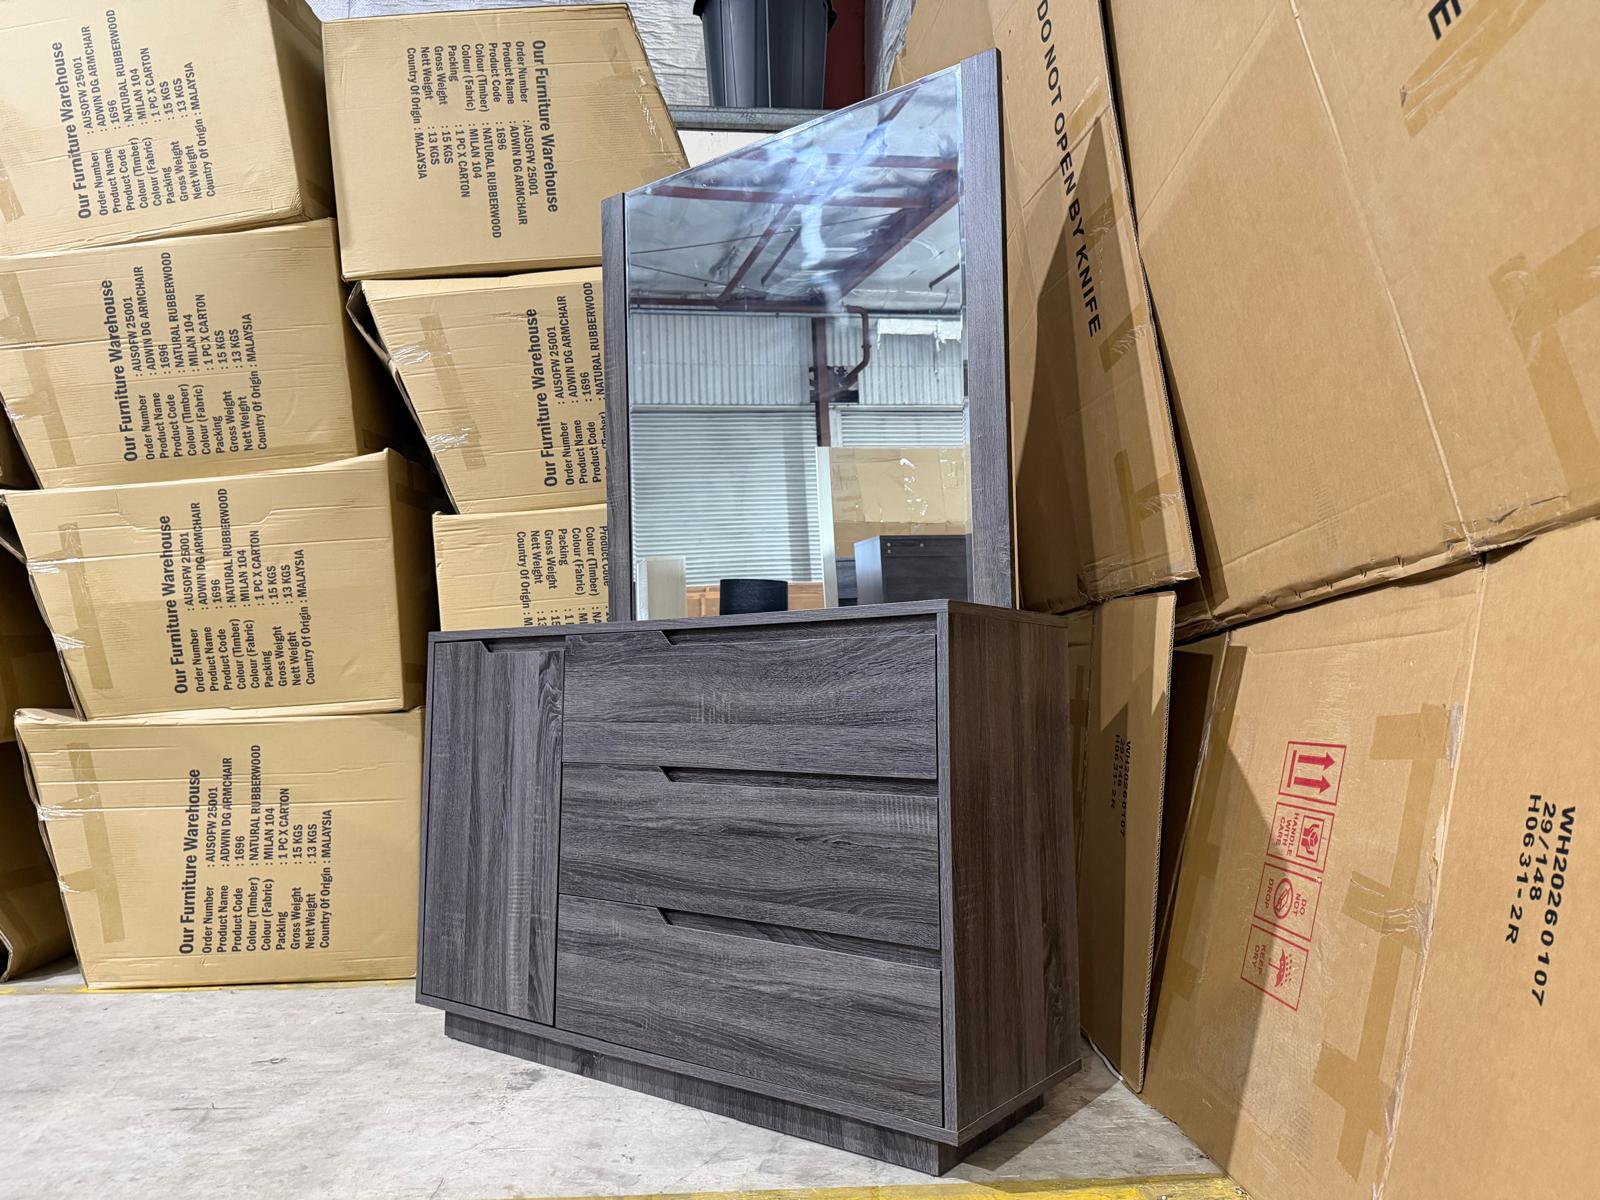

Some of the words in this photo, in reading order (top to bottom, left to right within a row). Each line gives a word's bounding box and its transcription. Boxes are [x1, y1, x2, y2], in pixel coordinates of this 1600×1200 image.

[1037, 0, 1052, 42] DO
[407, 48, 417, 82] Country
[421, 47, 431, 66] Nett
[434, 46, 443, 71] Gross
[448, 45, 459, 81] Packing
[461, 44, 471, 73] Colour
[475, 44, 485, 72] Colour
[488, 43, 500, 77] Product
[502, 42, 513, 76] Product
[515, 41, 525, 65] Order
[532, 40, 545, 64] Our
[52, 42, 74, 122] Warehouse
[72, 56, 86, 87] 25001
[422, 68, 433, 99] Weight
[518, 68, 529, 103] Number
[1044, 45, 1062, 107] NOT
[410, 85, 420, 95] Of
[436, 73, 448, 105] Weight
[462, 75, 476, 111] (Fabric)
[476, 75, 490, 112] (Timber)
[492, 79, 502, 102] Code
[505, 78, 515, 104] Name
[535, 68, 551, 131] Furniture
[78, 90, 93, 128] AUSOFW
[410, 97, 422, 123] Origin
[428, 132, 438, 143] 13
[442, 131, 451, 142] 15
[456, 138, 466, 150] PC
[469, 129, 480, 158] MILAN
[483, 128, 495, 169] NATURAL
[496, 128, 507, 150] 1696
[510, 126, 521, 156] ADWIN
[523, 125, 535, 163] AUSOFW
[66, 125, 87, 190] Furniture
[414, 133, 426, 179] MALAYSIA
[429, 146, 439, 164] KGS
[443, 145, 453, 163] KGS
[513, 159, 523, 172] DG
[1055, 112, 1077, 196] OPEN
[91, 152, 103, 188] Number
[458, 160, 470, 197] CARTON
[472, 161, 482, 179] 104
[527, 166, 538, 196] 25001
[541, 134, 558, 211] Warehouse
[78, 194, 92, 218] Our
[97, 190, 108, 215] Order
[486, 172, 501, 238] RUBBERWOOD
[514, 174, 527, 224] ARMCHAIR
[1068, 198, 1084, 237] BY
[1076, 245, 1101, 337] KNIFE
[101, 280, 122, 362] Warehouse
[123, 297, 136, 328] 25001
[557, 296, 572, 347] ARMCHAIR
[583, 282, 600, 350] RUBBERWOOD
[127, 331, 142, 371] AUSOFW
[526, 309, 545, 390] Warehouse
[546, 326, 559, 356] 25001
[563, 350, 573, 364] DG
[550, 359, 564, 398] AUSOFW
[565, 366, 577, 397] ADWIN
[580, 372, 591, 395] 1696
[591, 352, 606, 395] NATURAL
[113, 366, 133, 432] Furniture
[138, 395, 150, 432] Number
[536, 393, 554, 458] Furniture
[560, 421, 571, 457] Number
[574, 420, 583, 446] Name
[586, 421, 597, 445] Code
[123, 436, 137, 461] Our
[143, 434, 155, 459] Order
[544, 461, 558, 486] Our
[564, 459, 575, 484] Order
[575, 448, 588, 483] Product
[589, 446, 602, 482] Product
[179, 532, 191, 563] 25001
[517, 531, 527, 567] Country
[530, 530, 541, 550] Nett
[544, 529, 554, 555] Gross
[558, 528, 569, 565] Packing
[572, 527, 582, 557] Colour
[586, 526, 595, 556] Colour
[159, 516, 176, 596] Warehouse
[531, 552, 543, 584] Weight
[182, 566, 195, 605] AUSOFW
[520, 569, 529, 579] Of
[546, 557, 557, 589] Weight
[572, 559, 585, 595] (Fabric)
[586, 558, 599, 596] (Timber)
[520, 582, 531, 608] Origin
[167, 600, 184, 665] Furniture
[190, 629, 201, 665] Number
[173, 669, 187, 693] Our
[194, 667, 204, 692] Order
[222, 758, 233, 810] ARMCHAIR
[251, 745, 262, 814] RUBBERWOOD
[183, 769, 200, 851] Warehouse
[207, 787, 217, 818] 25001
[265, 807, 274, 826] 104
[279, 788, 289, 827] CARTON
[221, 812, 231, 826] DG
[293, 824, 303, 844] KGS
[307, 824, 317, 843] KGS
[321, 810, 332, 858] MALAYSIA
[1275, 816, 1286, 847] CARE
[1281, 819, 1292, 847] WITH
[1286, 812, 1299, 856] HANDLE
[205, 821, 216, 862] AUSOFW
[220, 829, 230, 861] ADWIN
[234, 836, 244, 860] 1696
[249, 816, 260, 860] NATURAL
[263, 829, 274, 859] MILAN
[278, 838, 288, 850] PC
[292, 847, 302, 858] 15
[307, 846, 316, 858] 13
[1529, 802, 1556, 901] 29/148
[320, 867, 332, 895] Origin
[1505, 794, 1541, 945] H0631-2R
[180, 855, 197, 923] Furniture
[218, 885, 228, 912] Name
[233, 887, 243, 912] Code
[247, 877, 260, 917] (Timber)
[262, 879, 274, 917] (Fabric)
[291, 887, 303, 920] Weight
[320, 898, 329, 909] Of
[1264, 878, 1274, 909] DROP
[203, 886, 214, 924] Number
[305, 893, 317, 926] Weight
[1292, 893, 1301, 917] NOT
[1299, 898, 1308, 916] DO
[1531, 806, 1576, 1006] WH20260107
[179, 927, 194, 954] Our
[202, 926, 212, 953] Order
[217, 915, 227, 952] Product
[232, 914, 242, 952] Product
[246, 920, 256, 951] Colour
[261, 919, 271, 951] Colour
[276, 912, 288, 950] Packing
[290, 922, 300, 949] Gross
[305, 928, 315, 949] Nett
[319, 911, 331, 948] Country
[1251, 944, 1260, 970] DRY
[1257, 944, 1267, 975] KEEP
